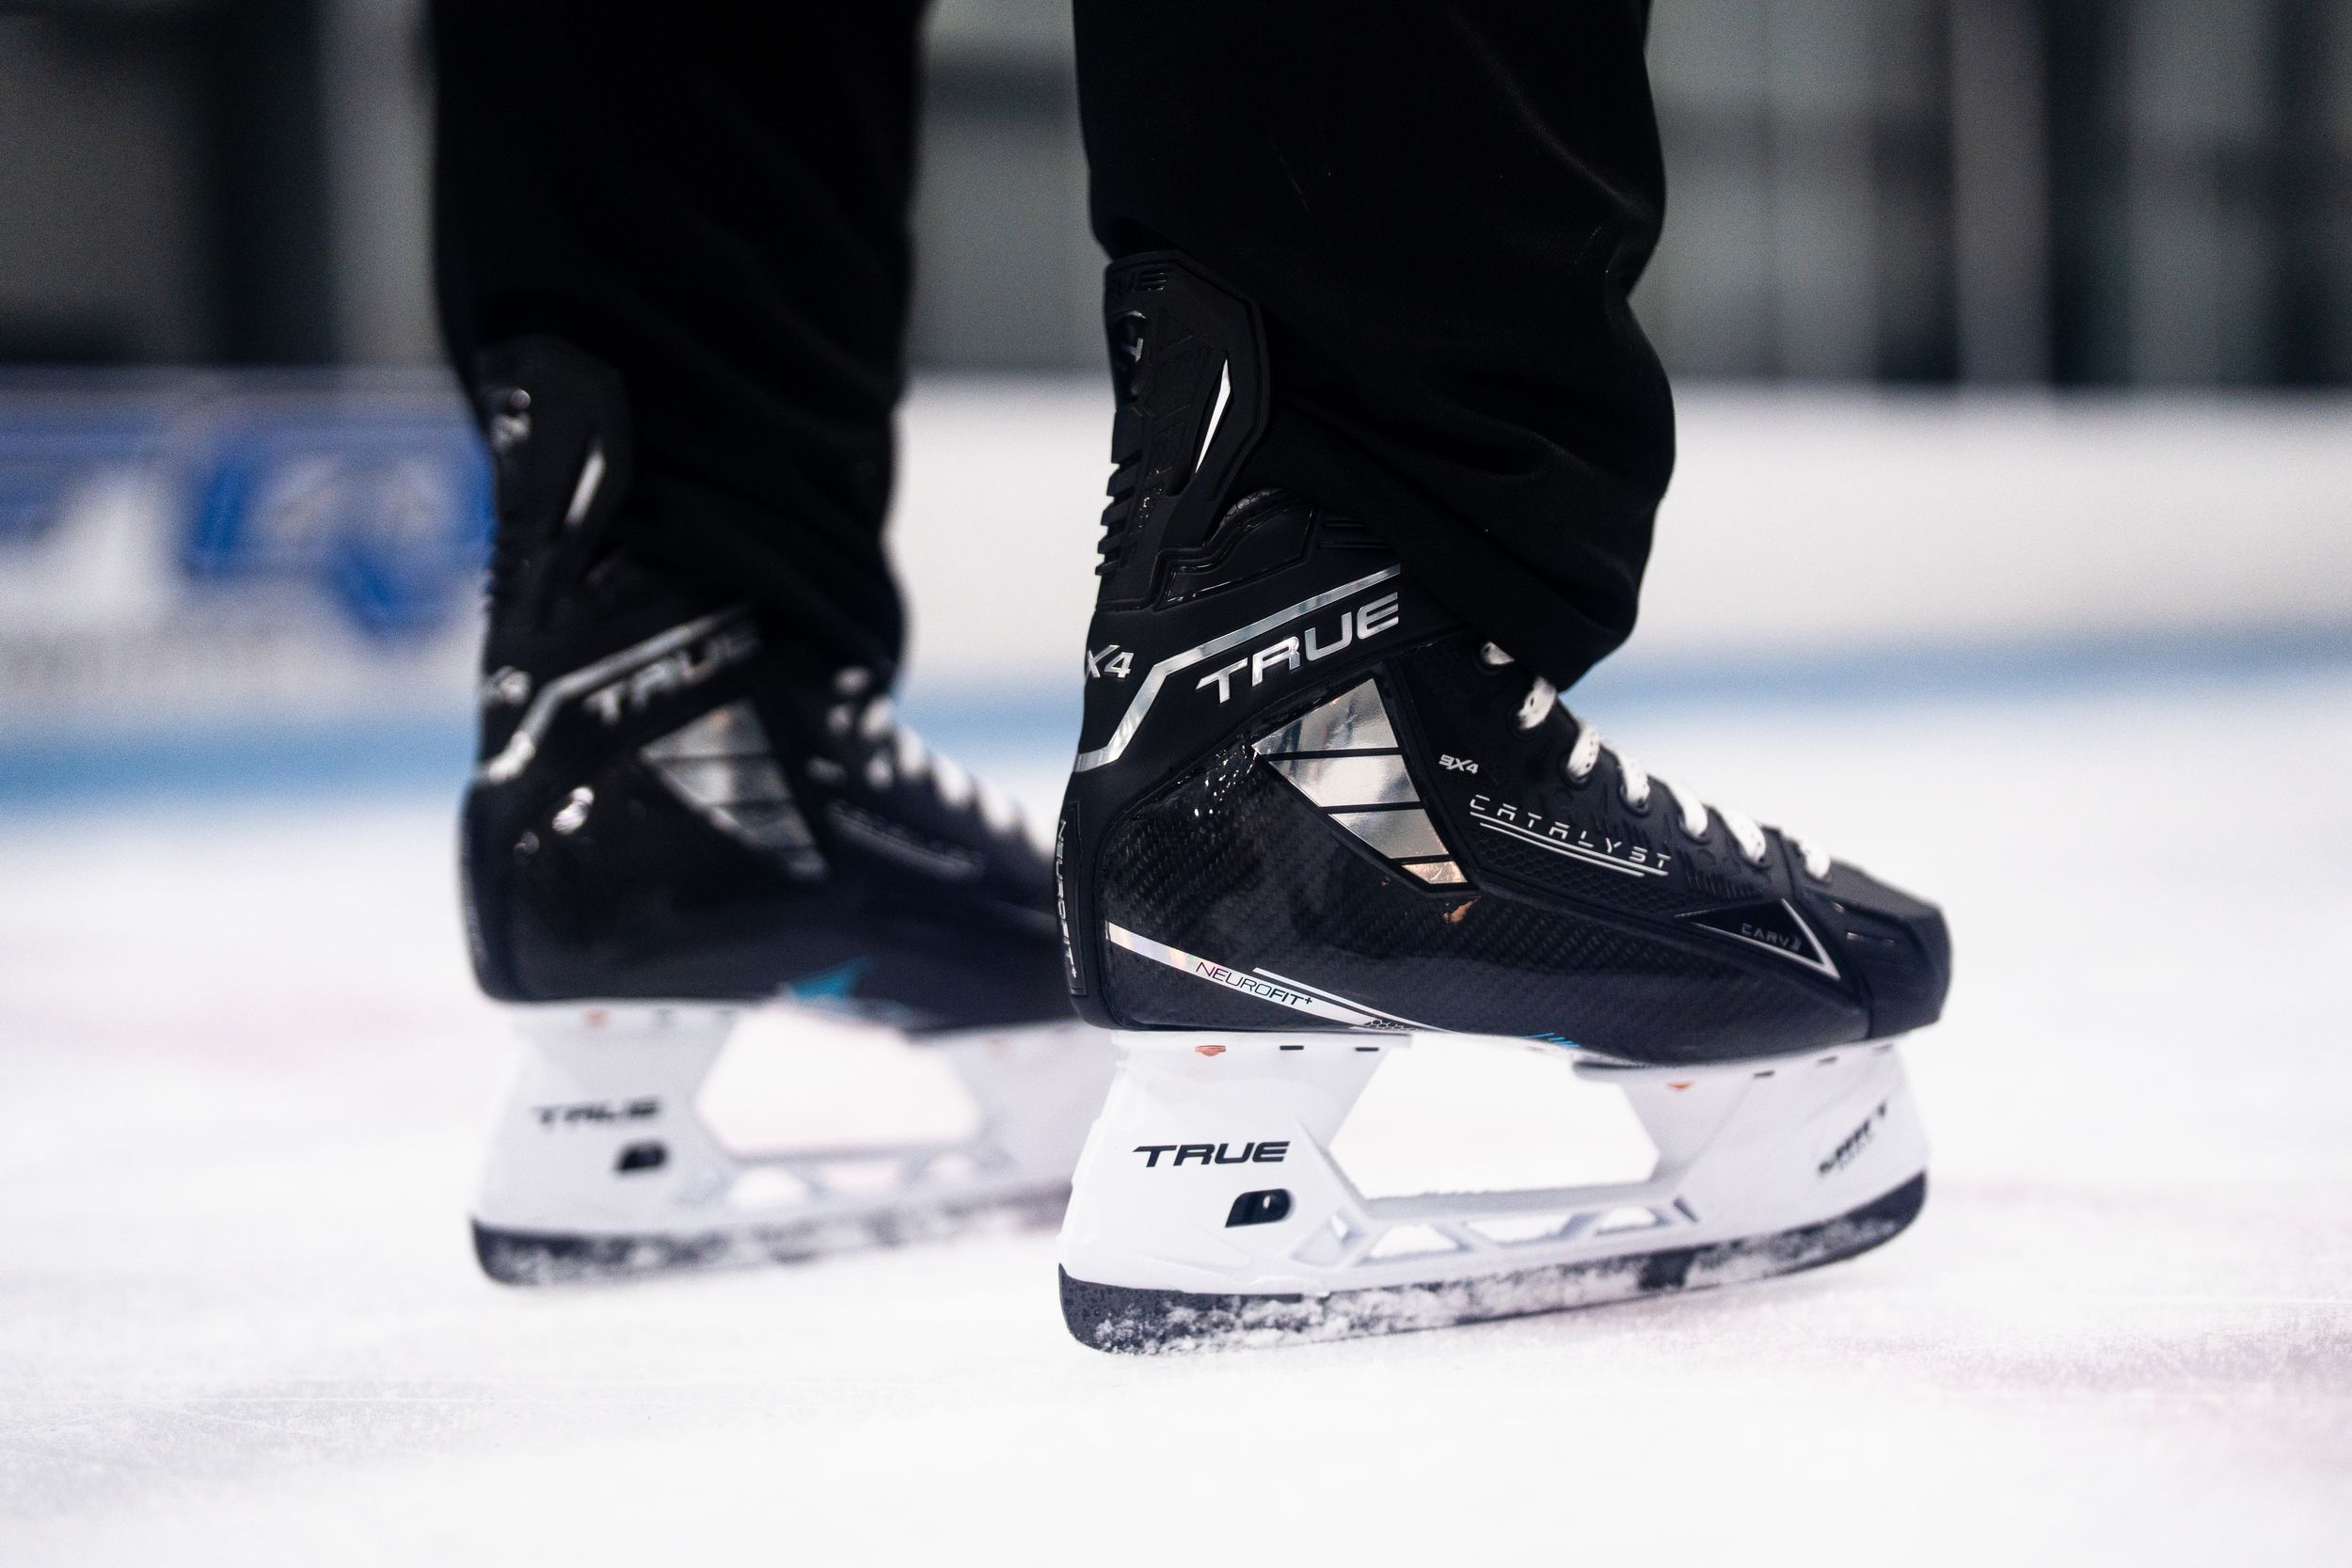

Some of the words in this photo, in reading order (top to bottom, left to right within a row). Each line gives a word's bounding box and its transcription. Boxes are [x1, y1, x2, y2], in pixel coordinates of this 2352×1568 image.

[1196, 591, 1399, 704] TRUE
[1438, 753, 1479, 774] 9X4
[1470, 794, 1671, 868] CATALYST
[1196, 961, 1313, 1006] NEUROFIT+
[1132, 1141, 1291, 1168] TRUE
